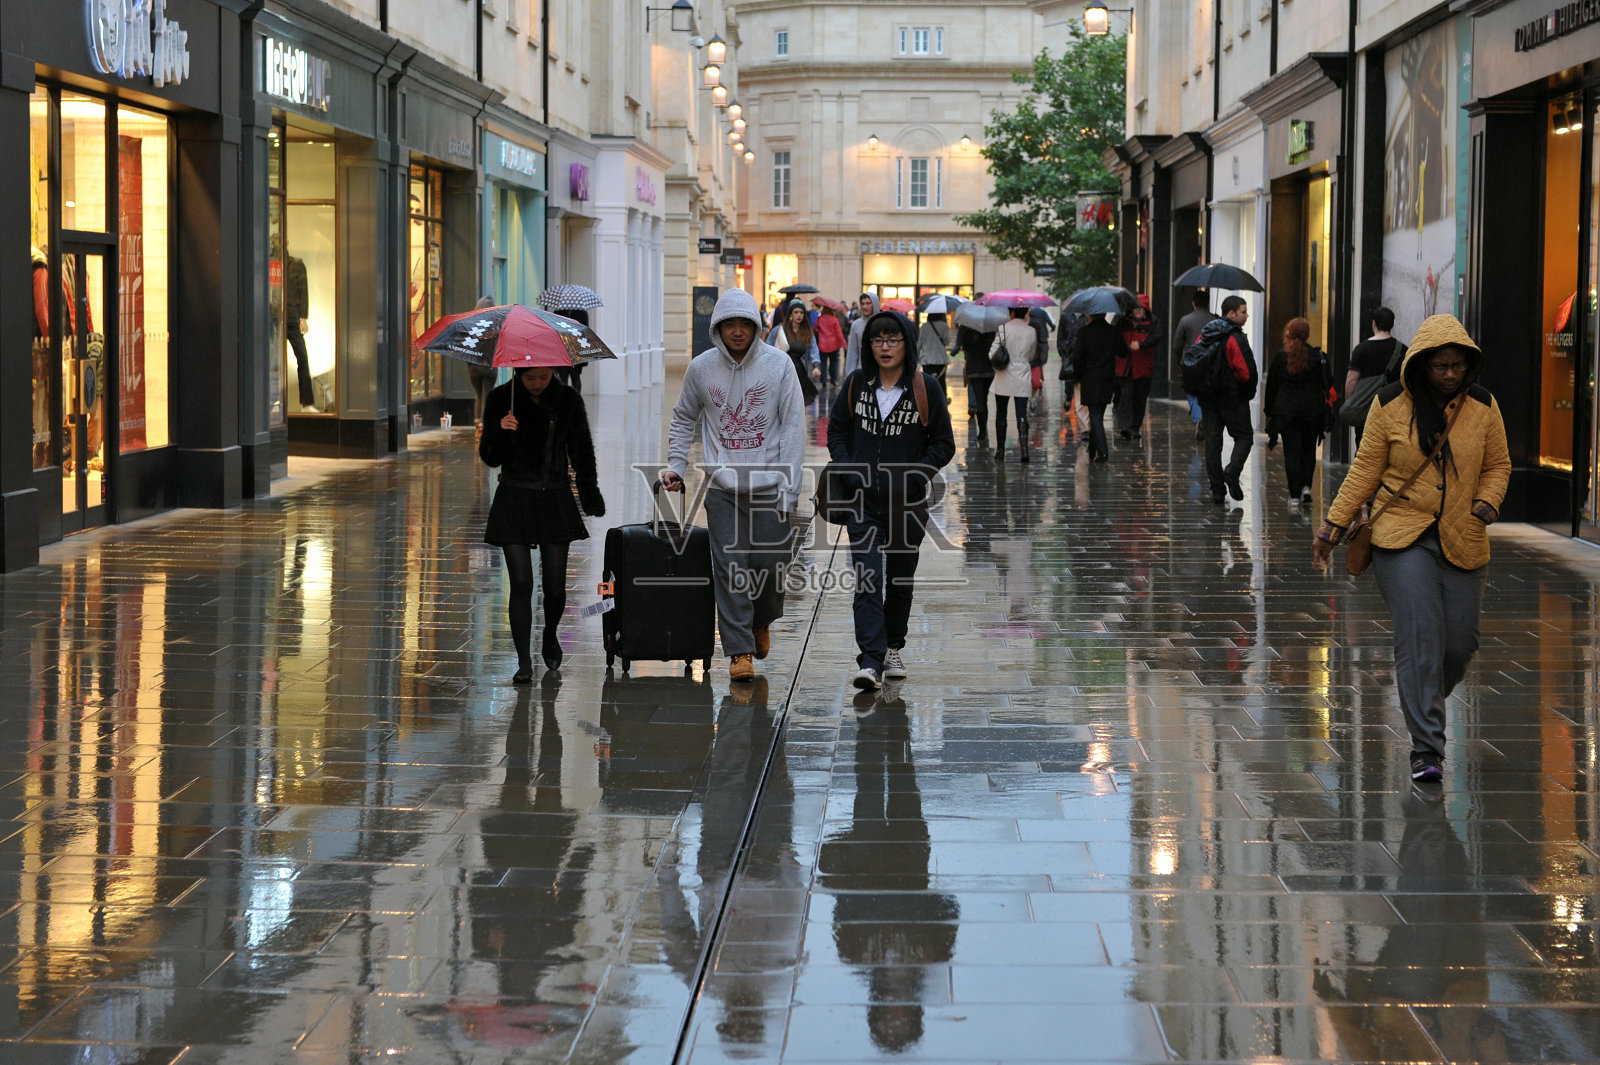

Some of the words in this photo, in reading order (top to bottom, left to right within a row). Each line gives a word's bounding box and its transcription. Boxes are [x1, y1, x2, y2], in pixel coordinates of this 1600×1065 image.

[1514, 14, 1548, 52] TOMMY
[1555, 0, 1600, 36] HILFIGER
[265, 38, 332, 112] REPUBLIC
[1081, 202, 1112, 223] H&M
[860, 241, 978, 254] DEBENHAMS
[119, 275, 142, 392] ALE
[855, 400, 920, 425] HOLLISTER
[861, 419, 902, 436] MALIBU
[723, 438, 761, 450] HILFIGER
